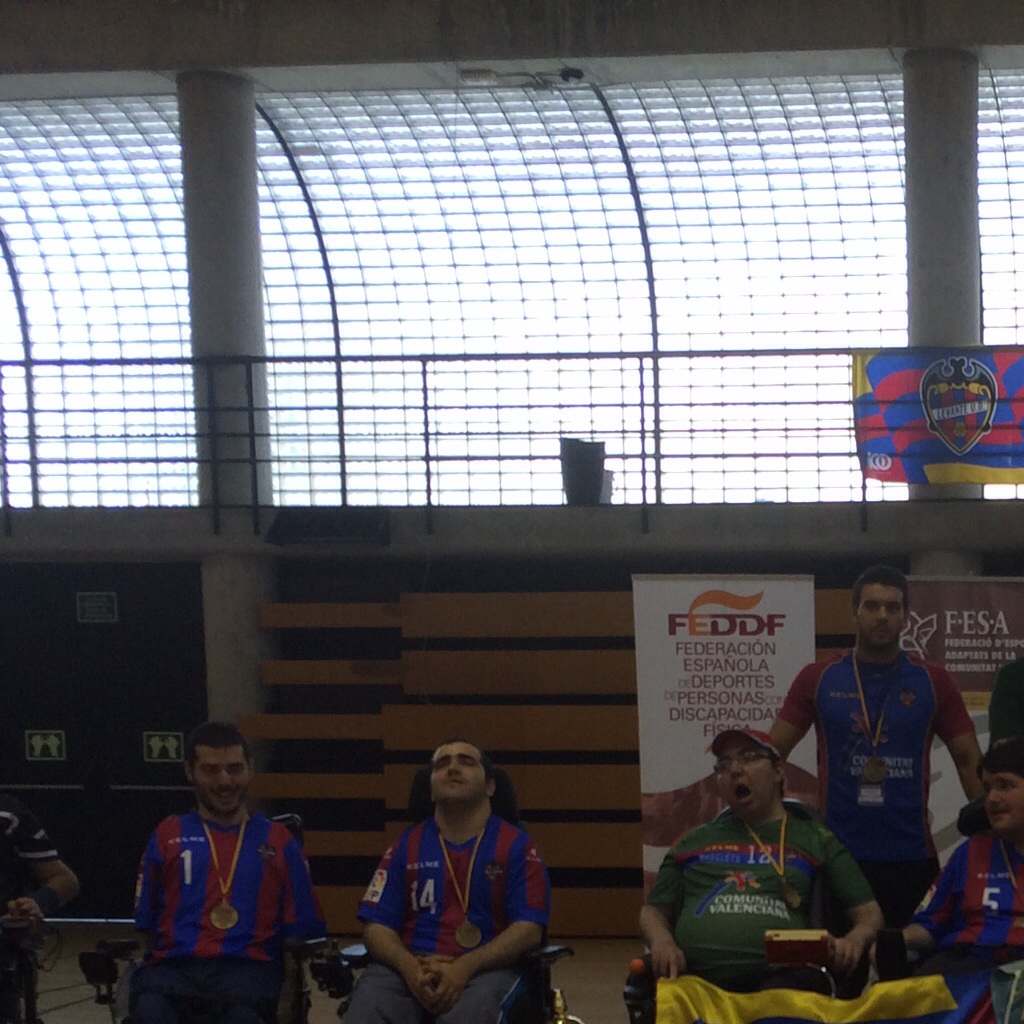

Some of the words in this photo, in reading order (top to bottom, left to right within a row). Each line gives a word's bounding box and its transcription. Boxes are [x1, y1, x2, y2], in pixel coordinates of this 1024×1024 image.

[668, 613, 786, 636] FEDDF
[675, 638, 777, 656] FEDERACIÓN
[944, 637, 992, 648] FEDERACIÓ
[683, 655, 770, 672] ESPAÑOLA
[944, 651, 989, 660] ADAPTATS
[991, 651, 1003, 660] DE
[944, 663, 997, 673] COMUNITAT
[691, 674, 775, 689] DEPORTES
[677, 691, 765, 705] PERSONAS
[180, 849, 192, 885] 1
[410, 878, 438, 914] 14
[982, 886, 1001, 911] 5
